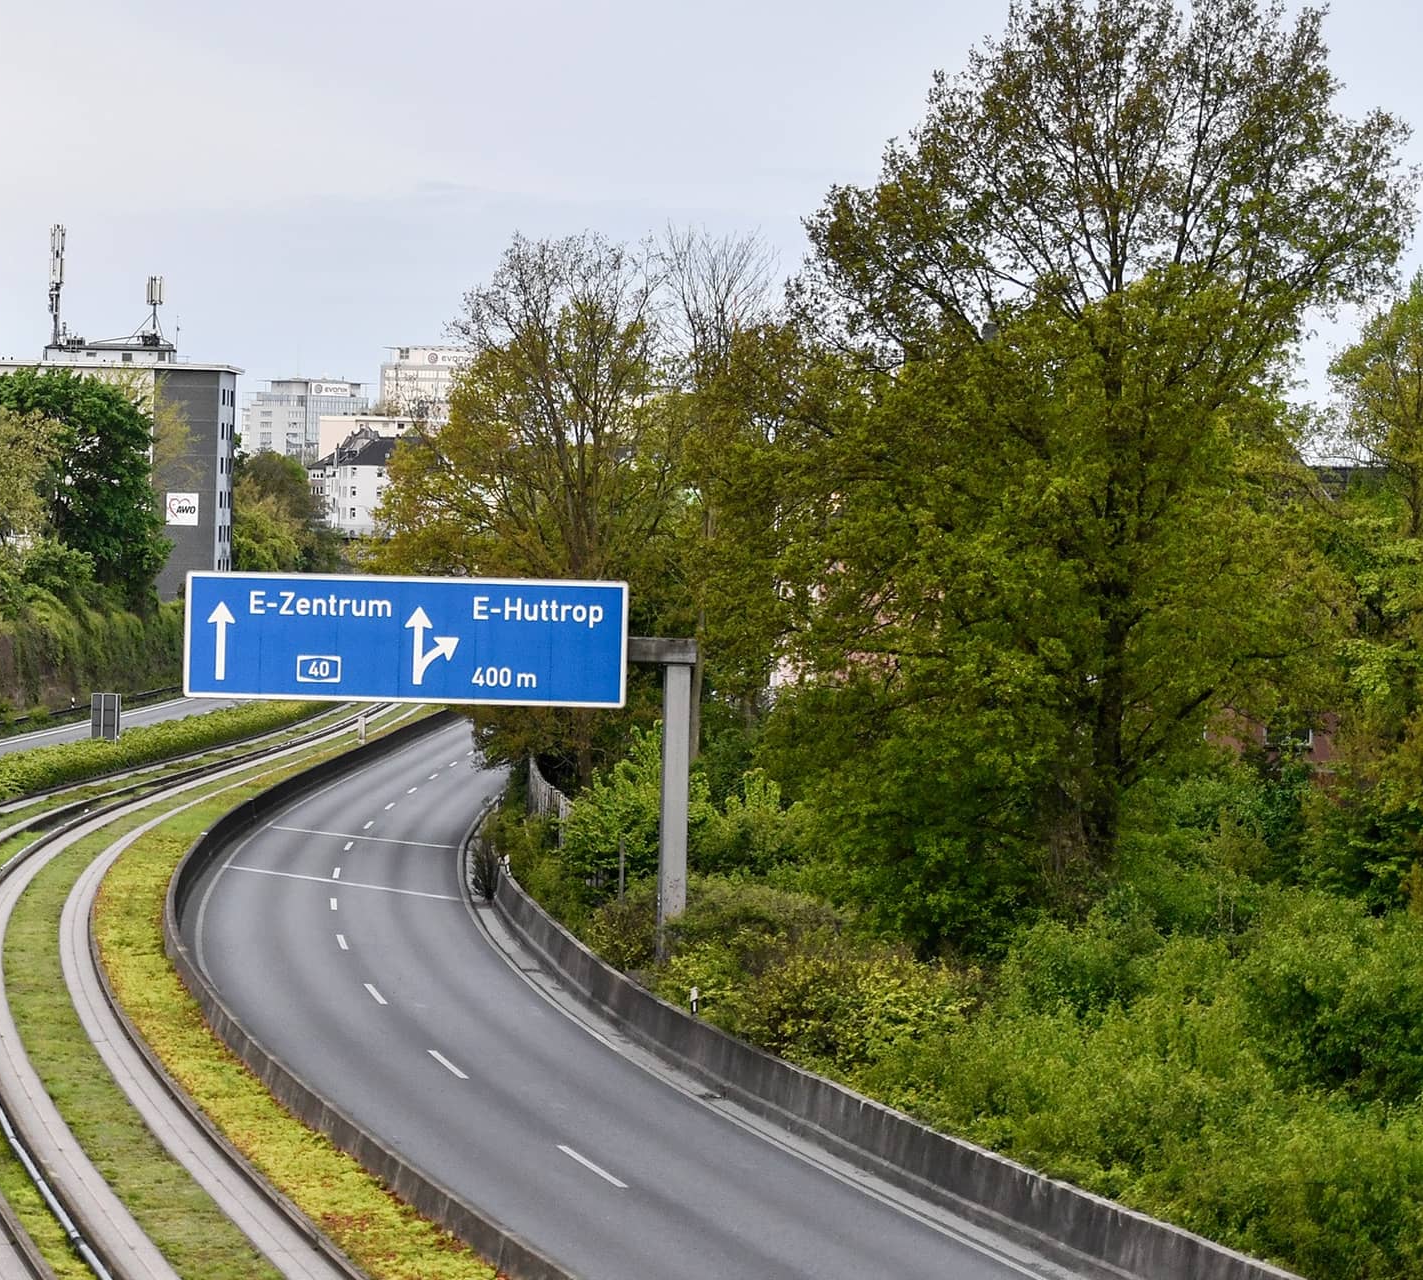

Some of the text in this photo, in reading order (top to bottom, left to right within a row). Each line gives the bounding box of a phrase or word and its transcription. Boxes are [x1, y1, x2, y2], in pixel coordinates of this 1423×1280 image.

[176, 505, 196, 514] AWO
[249, 591, 392, 618] E-Zentrum
[473, 596, 604, 628] E-Huttrop
[308, 662, 330, 677] 40
[471, 666, 537, 688] 400 m
